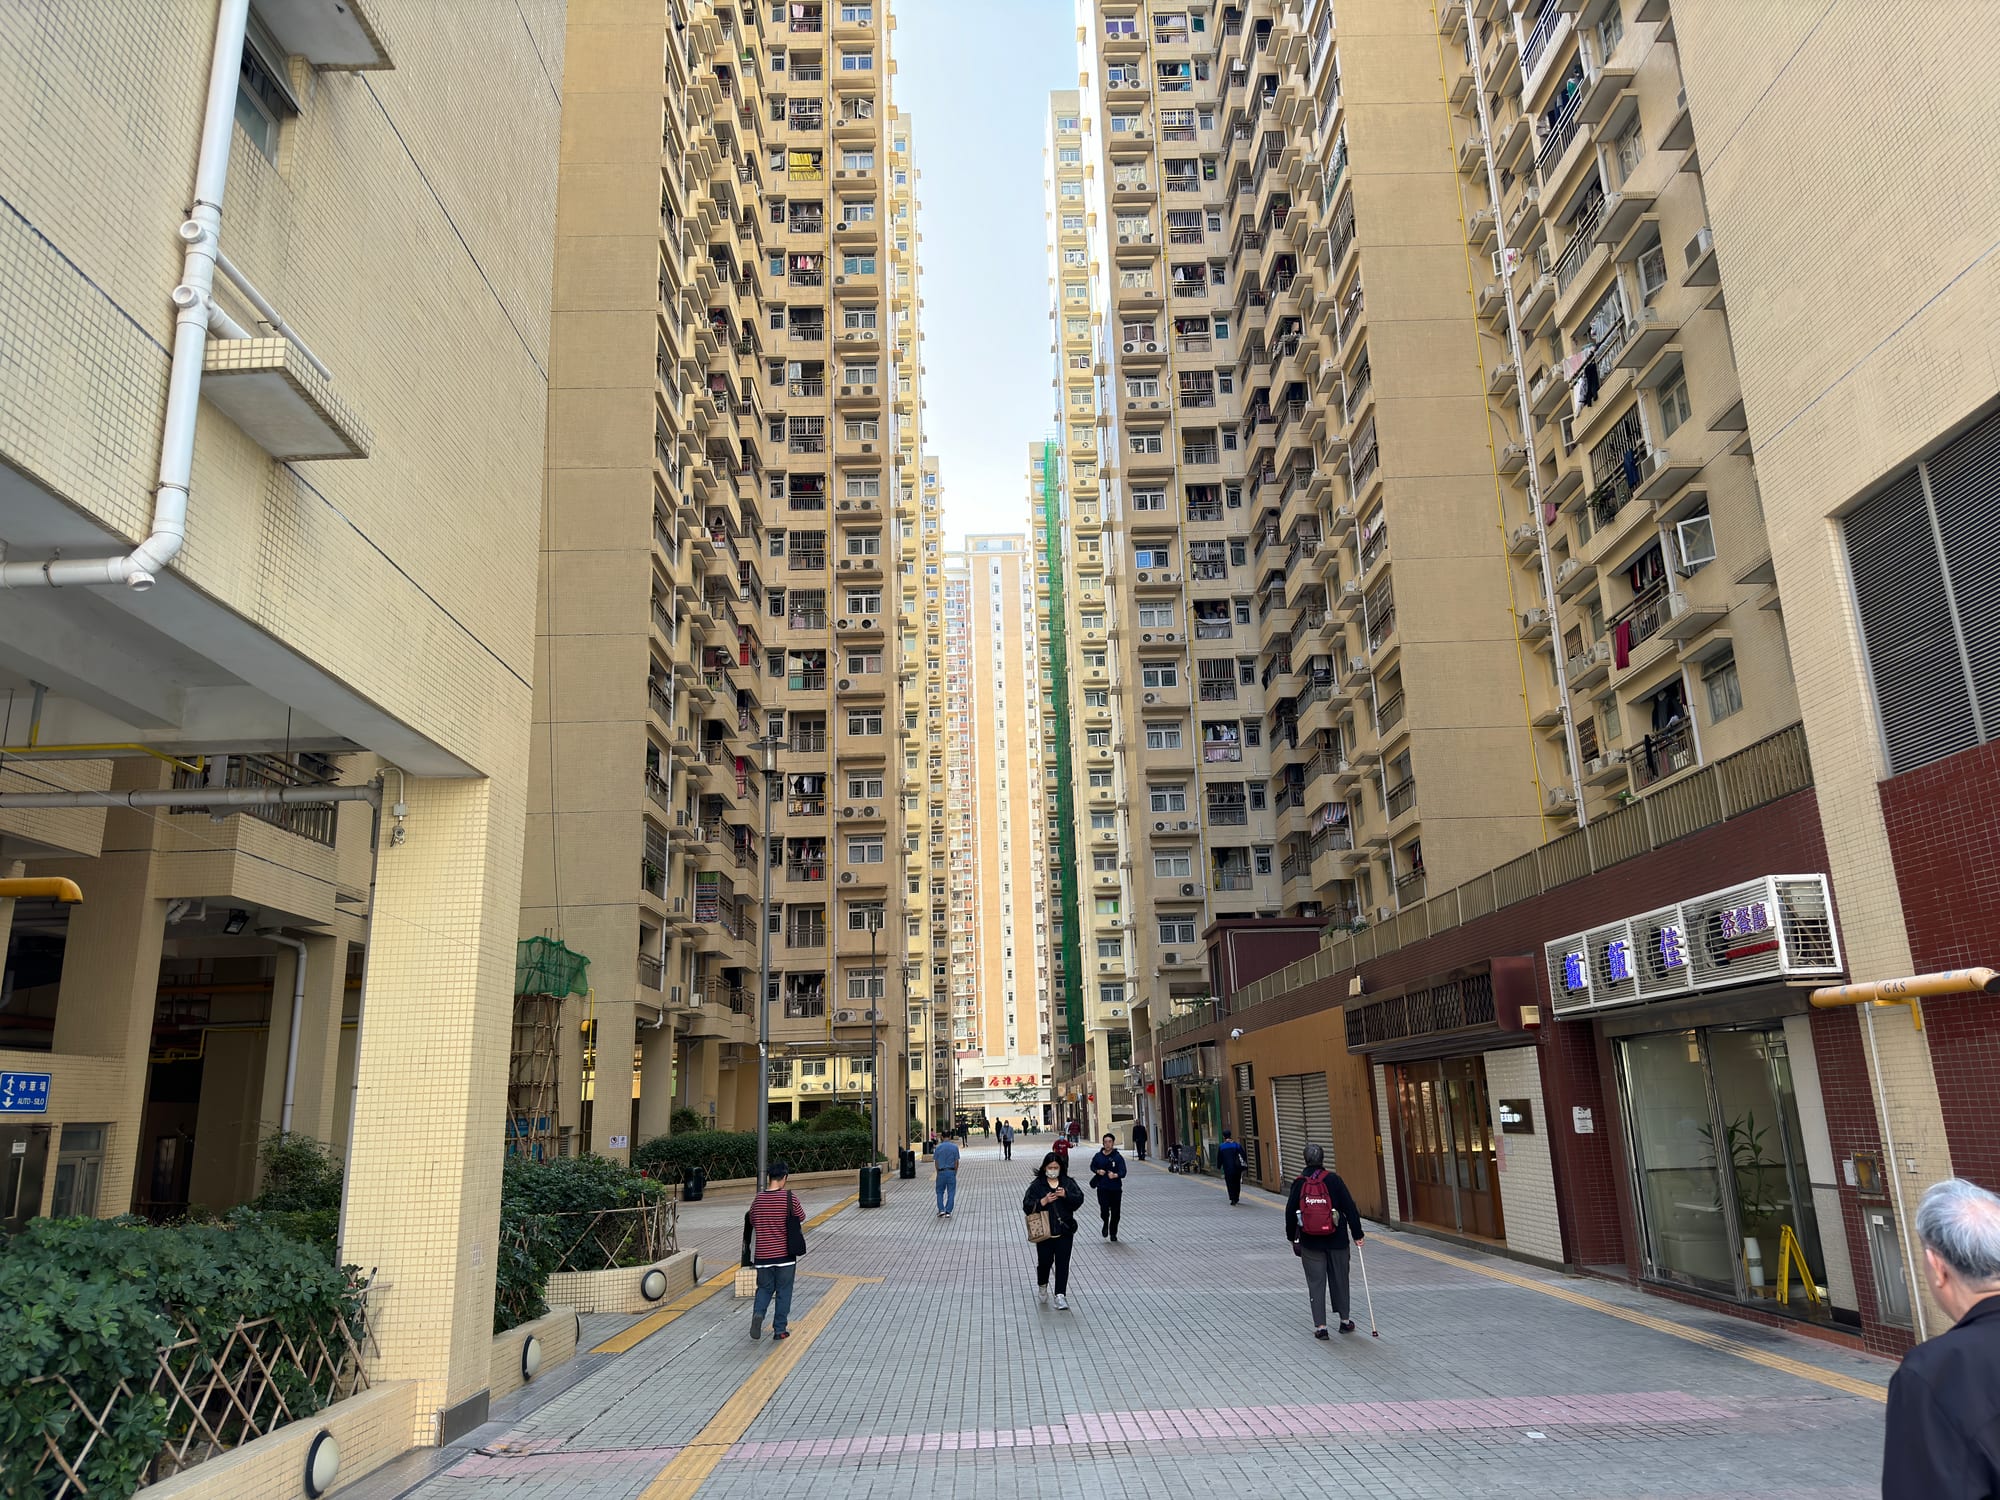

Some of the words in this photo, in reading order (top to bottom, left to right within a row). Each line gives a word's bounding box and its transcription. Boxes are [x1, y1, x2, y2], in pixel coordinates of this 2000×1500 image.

[1720, 902, 1768, 939] 茶餐廳
[1884, 981, 1906, 993] GAS
[19, 1080, 46, 1092] 停車場
